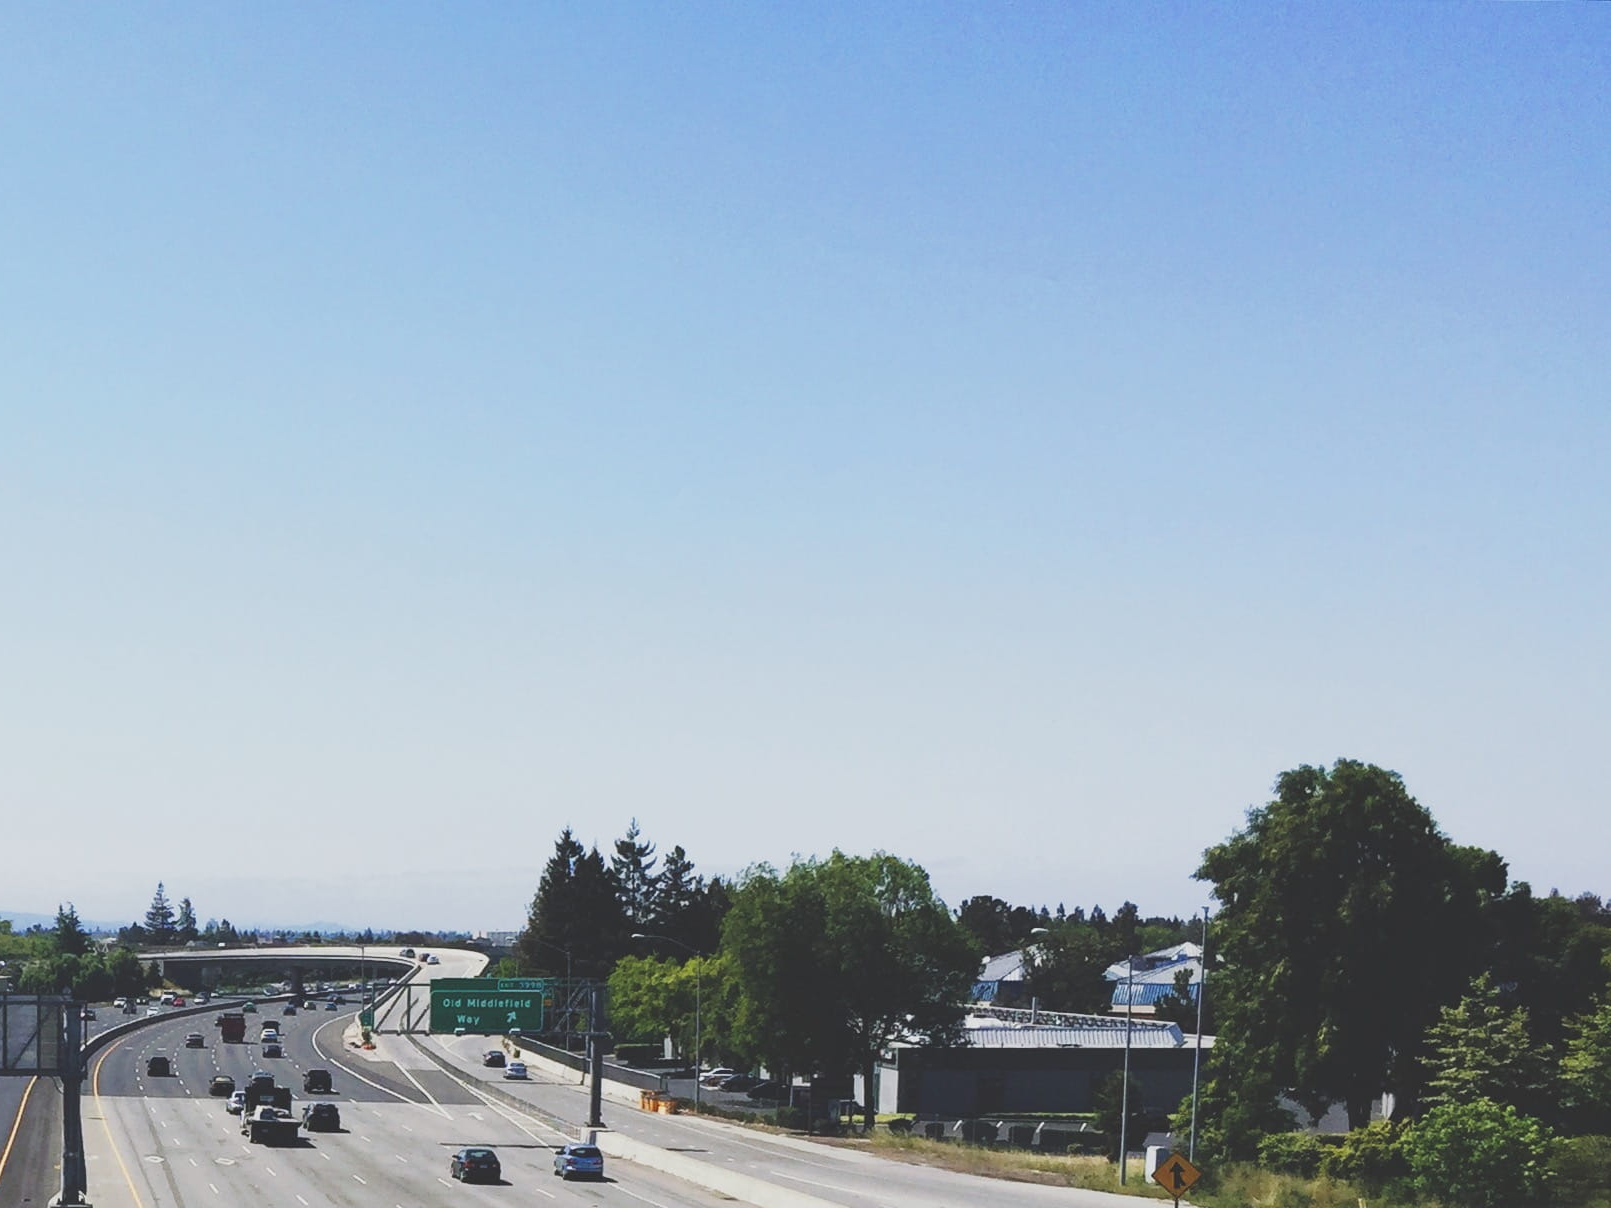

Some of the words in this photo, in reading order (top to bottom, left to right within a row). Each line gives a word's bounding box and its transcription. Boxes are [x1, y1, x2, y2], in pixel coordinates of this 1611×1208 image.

[442, 998, 462, 1008] Old
[467, 998, 531, 1008] Middlefield
[457, 1015, 480, 1025] Way
